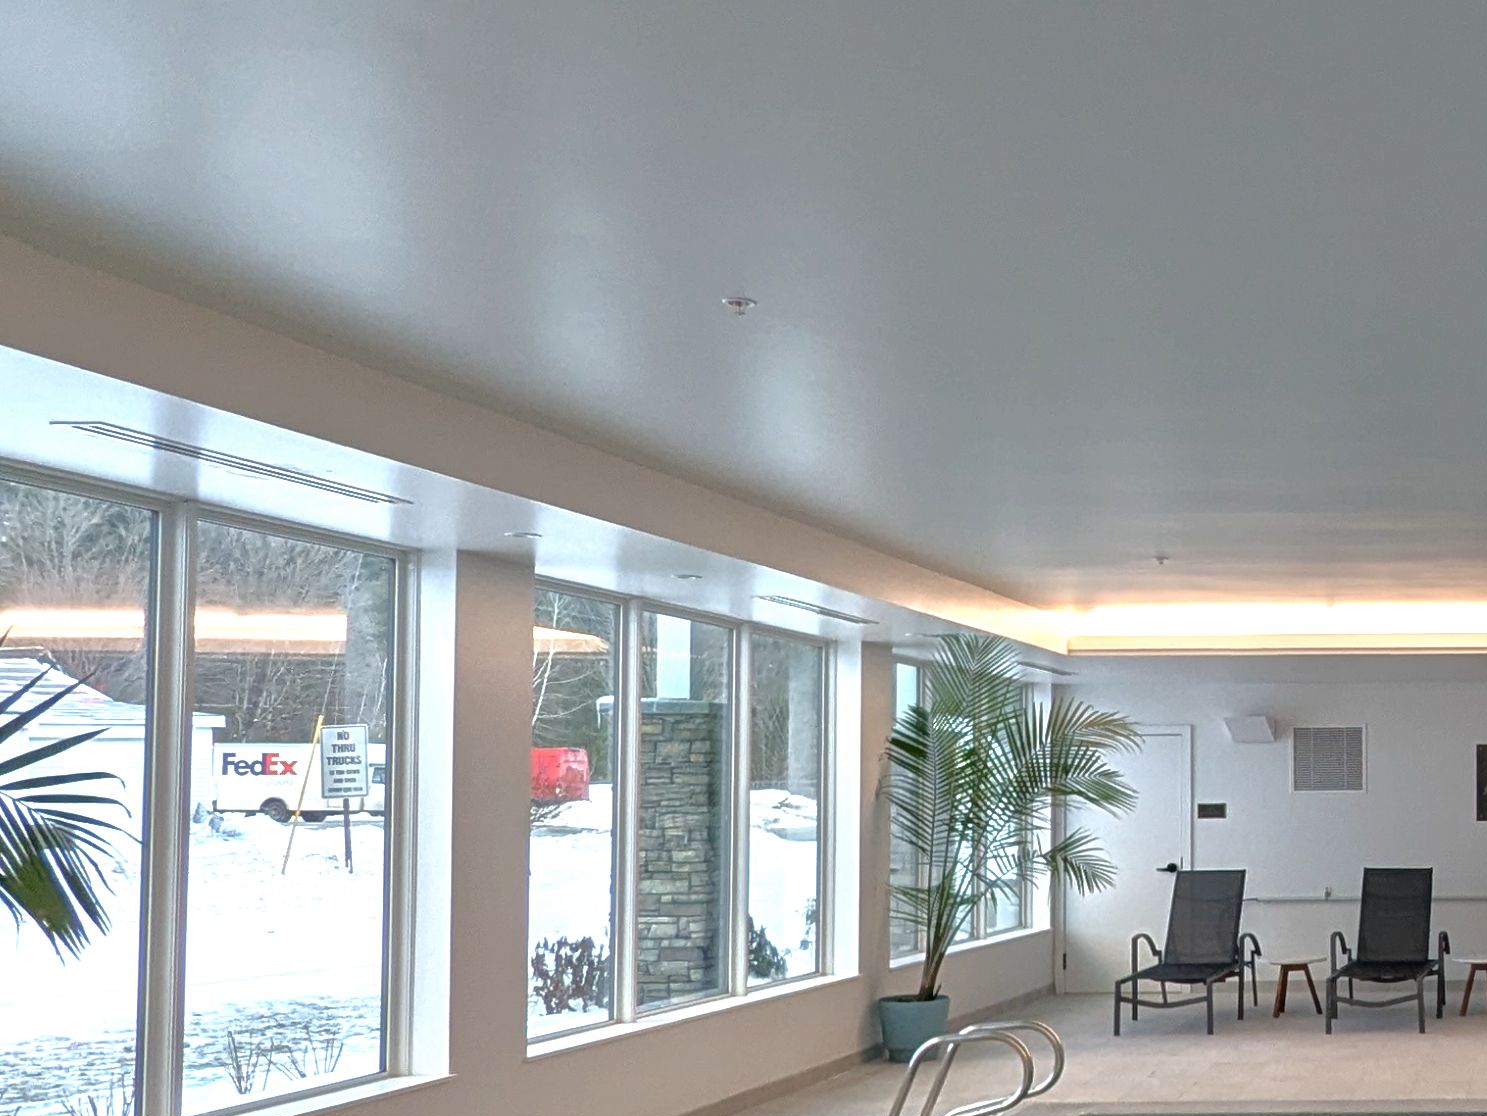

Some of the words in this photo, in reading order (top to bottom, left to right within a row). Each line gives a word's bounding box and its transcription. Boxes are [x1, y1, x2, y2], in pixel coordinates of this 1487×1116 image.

[337, 731, 349, 740] NO
[331, 743, 355, 753] THRU
[222, 753, 297, 776] FedEx
[326, 756, 362, 765] TRUCKS
